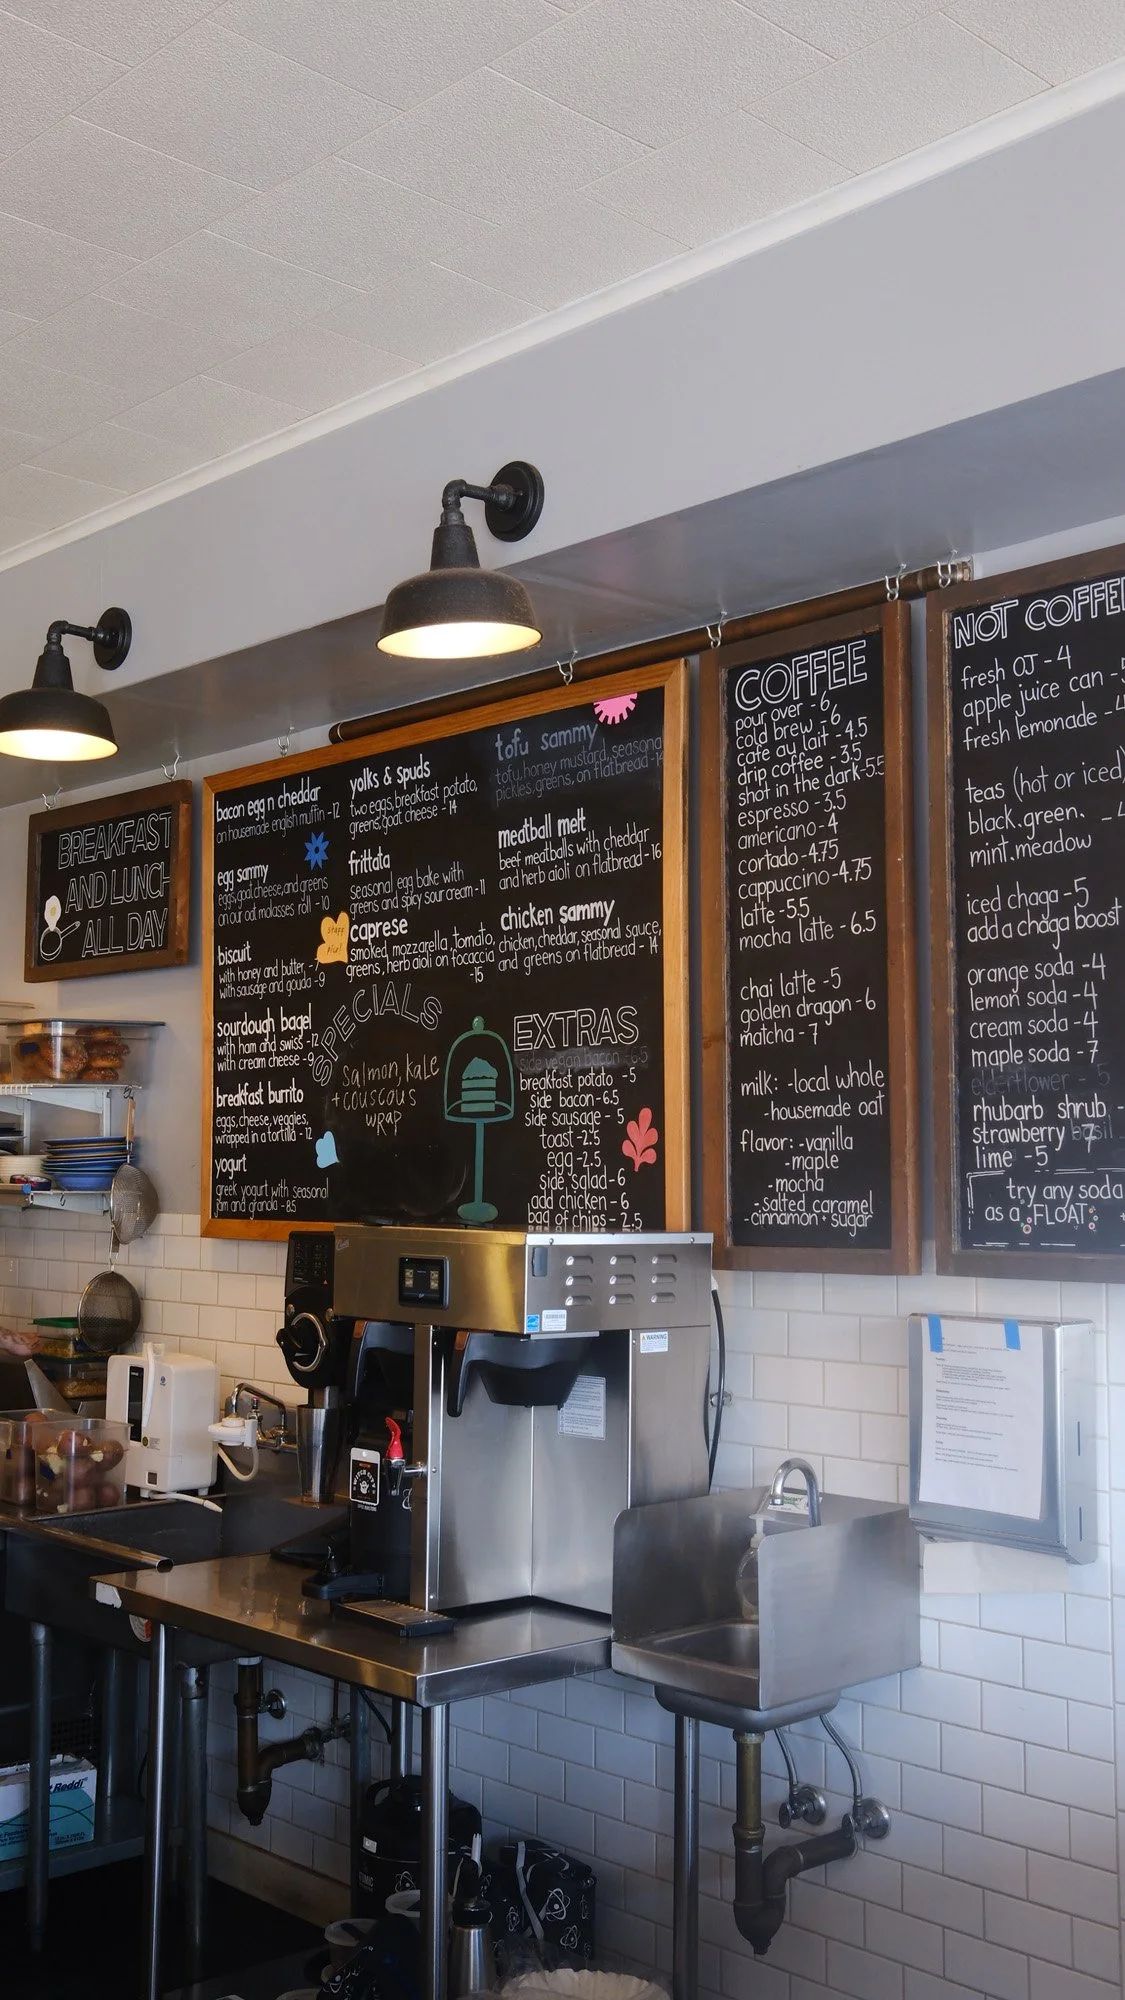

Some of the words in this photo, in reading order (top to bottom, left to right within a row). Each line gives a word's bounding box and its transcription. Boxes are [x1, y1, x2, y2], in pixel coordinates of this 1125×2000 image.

[954, 600, 1018, 649] NOT
[735, 640, 867, 711] COFFEE
[961, 658, 1005, 690] fresh
[1013, 654, 1038, 676] OJ
[963, 684, 1011, 726] apple
[1015, 681, 1059, 717] juice
[1070, 671, 1103, 692] can
[736, 711, 767, 736] pour
[771, 703, 803, 722] over
[736, 722, 767, 749] cold
[774, 719, 812, 741] brew
[963, 720, 1010, 750] fresh
[1015, 701, 1097, 739] lemonade
[495, 728, 528, 761] tofu
[541, 724, 598, 751] sammy
[737, 744, 770, 767] cafe
[776, 743, 796, 758] au
[803, 725, 829, 751] lait
[350, 768, 379, 799] yolks
[384, 766, 392, 785] &
[738, 767, 766, 786] drip
[772, 752, 823, 778] coffee
[965, 778, 1004, 803] teas
[1013, 766, 1048, 802] (hot
[1055, 772, 1075, 790] or
[217, 800, 244, 822] bacon
[248, 797, 265, 821] egg
[268, 797, 274, 811] n
[278, 776, 321, 809] cheddar
[738, 781, 770, 806] shot
[776, 783, 788, 798] in
[793, 774, 819, 794] the
[217, 832, 227, 843] on
[228, 819, 269, 841] housemade
[272, 809, 298, 837] english
[300, 804, 325, 825] muffin
[499, 813, 551, 849] meatball
[558, 807, 586, 837] melt
[738, 800, 809, 831] espresso
[58, 812, 172, 869] BREAKFAST
[499, 851, 521, 870] beef
[525, 838, 573, 866] meatballs
[576, 831, 600, 855] with
[604, 822, 649, 851] cheddar
[349, 846, 390, 876] frittata
[65, 871, 107, 913] AND
[218, 870, 234, 892] egg
[237, 865, 268, 883] sammy
[351, 871, 393, 900] seasonal
[397, 874, 413, 894] egg
[416, 865, 439, 888] bake
[442, 861, 464, 883] with
[350, 898, 379, 920] greens
[382, 891, 398, 910] and
[402, 891, 422, 912] spicy
[425, 890, 444, 904] sour
[446, 885, 473, 901] cream
[501, 902, 553, 931] chicken
[560, 900, 615, 926] sammy
[741, 901, 775, 929] latte
[967, 885, 1001, 914] iced
[1008, 881, 1059, 919] chaga
[82, 916, 123, 957] ALL
[127, 908, 167, 950] DAY
[350, 918, 408, 945] caprese
[740, 926, 791, 950] mocha
[799, 916, 834, 942] latte
[968, 914, 998, 942] add
[1002, 923, 1012, 939] a
[1017, 909, 1069, 950] chaga
[1074, 897, 1122, 930] boost
[218, 941, 251, 966] biscuit
[220, 983, 235, 999] with
[237, 983, 267, 999] sausage
[269, 979, 283, 993] and
[287, 971, 311, 997] gouda
[741, 979, 773, 1000] chai
[780, 969, 816, 996] latte
[968, 964, 1029, 993] orange
[1034, 952, 1074, 980] soda
[970, 988, 1020, 1012] lemon
[1027, 979, 1067, 1007] soda
[217, 1007, 275, 1041] sourdough
[281, 1002, 311, 1037] bagel
[514, 1005, 639, 1051] EXTRAS
[741, 999, 790, 1032] golden
[797, 996, 851, 1025] dragon
[970, 1019, 1022, 1039] cream
[1028, 1008, 1068, 1035] soda
[217, 1037, 235, 1055] with
[239, 1037, 256, 1055] ham
[260, 1034, 276, 1052] and
[280, 1036, 303, 1051] swiss
[312, 981, 442, 1086] SPECIALS
[217, 1053, 236, 1071] with
[239, 1055, 266, 1070] cream
[269, 1052, 299, 1067] cheese
[972, 1039, 1023, 1072] maple
[1028, 1040, 1070, 1064] soda
[217, 1082, 263, 1108] breakfast
[268, 1078, 303, 1104] burrito
[520, 1069, 573, 1091] breakfast
[578, 1066, 613, 1092] potato
[742, 1071, 777, 1096] milk:
[836, 1059, 885, 1089] whole
[530, 1092, 552, 1108] side
[560, 1091, 594, 1107] bacon
[858, 1091, 884, 1116] oat
[973, 1095, 1044, 1122] rhubarb
[1058, 1093, 1106, 1120] shrub
[539, 1127, 573, 1149] toast
[740, 1129, 793, 1152] flavor:
[972, 1123, 1065, 1151] strawberry
[215, 1154, 247, 1180] yogurt
[547, 1152, 573, 1176] egg
[976, 1147, 1012, 1169] lime
[540, 1171, 564, 1190] side
[571, 1165, 607, 1190] salad
[1006, 1178, 1036, 1207] try
[1043, 1184, 1073, 1209] any
[1079, 1174, 1123, 1200] soda
[985, 1204, 1004, 1221] as
[1009, 1206, 1020, 1222] a
[1032, 1203, 1088, 1226] FLOAT
